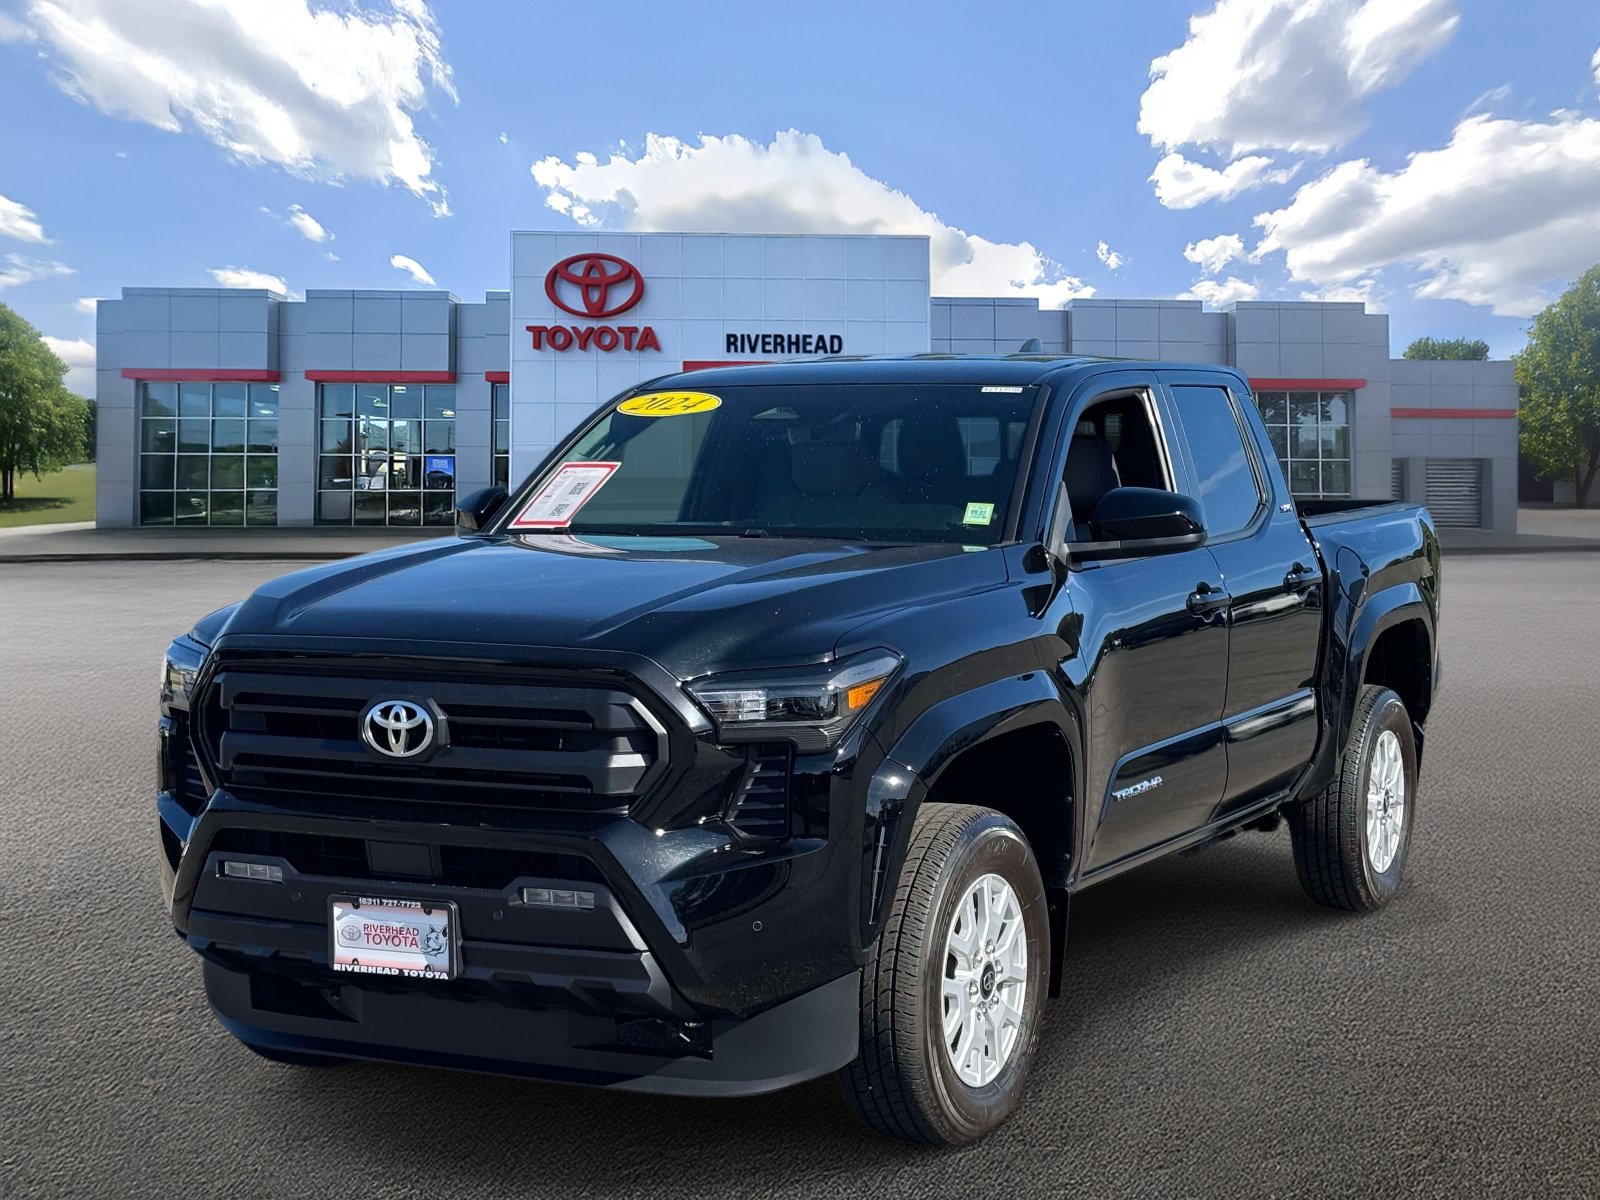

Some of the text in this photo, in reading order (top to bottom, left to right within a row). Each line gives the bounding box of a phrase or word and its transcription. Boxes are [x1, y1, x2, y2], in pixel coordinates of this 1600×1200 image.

[526, 325, 661, 352] TOYOTA
[725, 333, 843, 355] RIVERHEAD
[627, 397, 711, 410] 2024
[1112, 776, 1163, 801] TACOMA
[359, 897, 380, 906] (631)
[363, 923, 420, 937] RIVERHEAD
[364, 932, 419, 949] TOYOTA
[333, 963, 449, 980] RIVERHEAD TOYOTA
